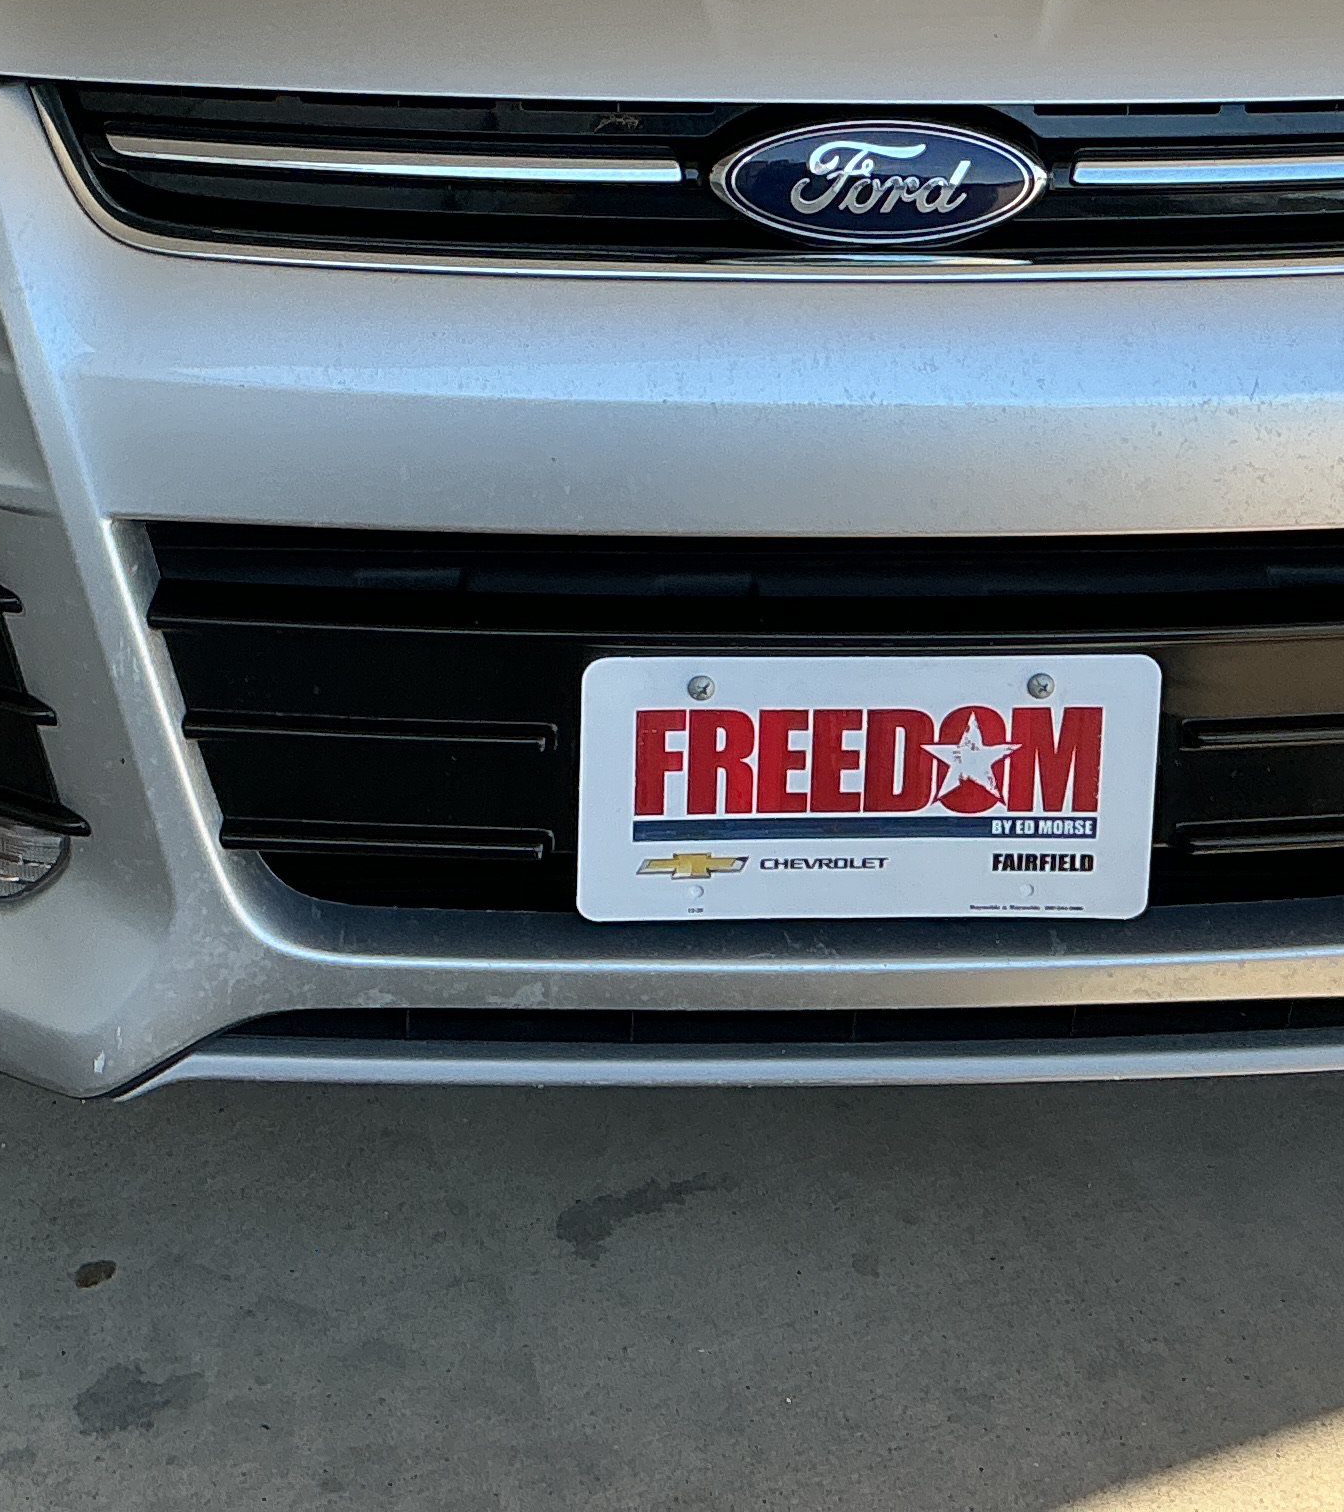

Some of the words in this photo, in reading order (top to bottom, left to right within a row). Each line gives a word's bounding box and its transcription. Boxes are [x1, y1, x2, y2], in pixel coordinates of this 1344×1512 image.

[790, 140, 971, 215] Ford
[634, 705, 1104, 816] FREEDOM
[992, 820, 1012, 835] BY
[1015, 820, 1035, 835] ED
[1038, 820, 1094, 835] MORSE
[759, 857, 889, 870] CHEVROLET
[992, 852, 1095, 873] FAIRFIELD
